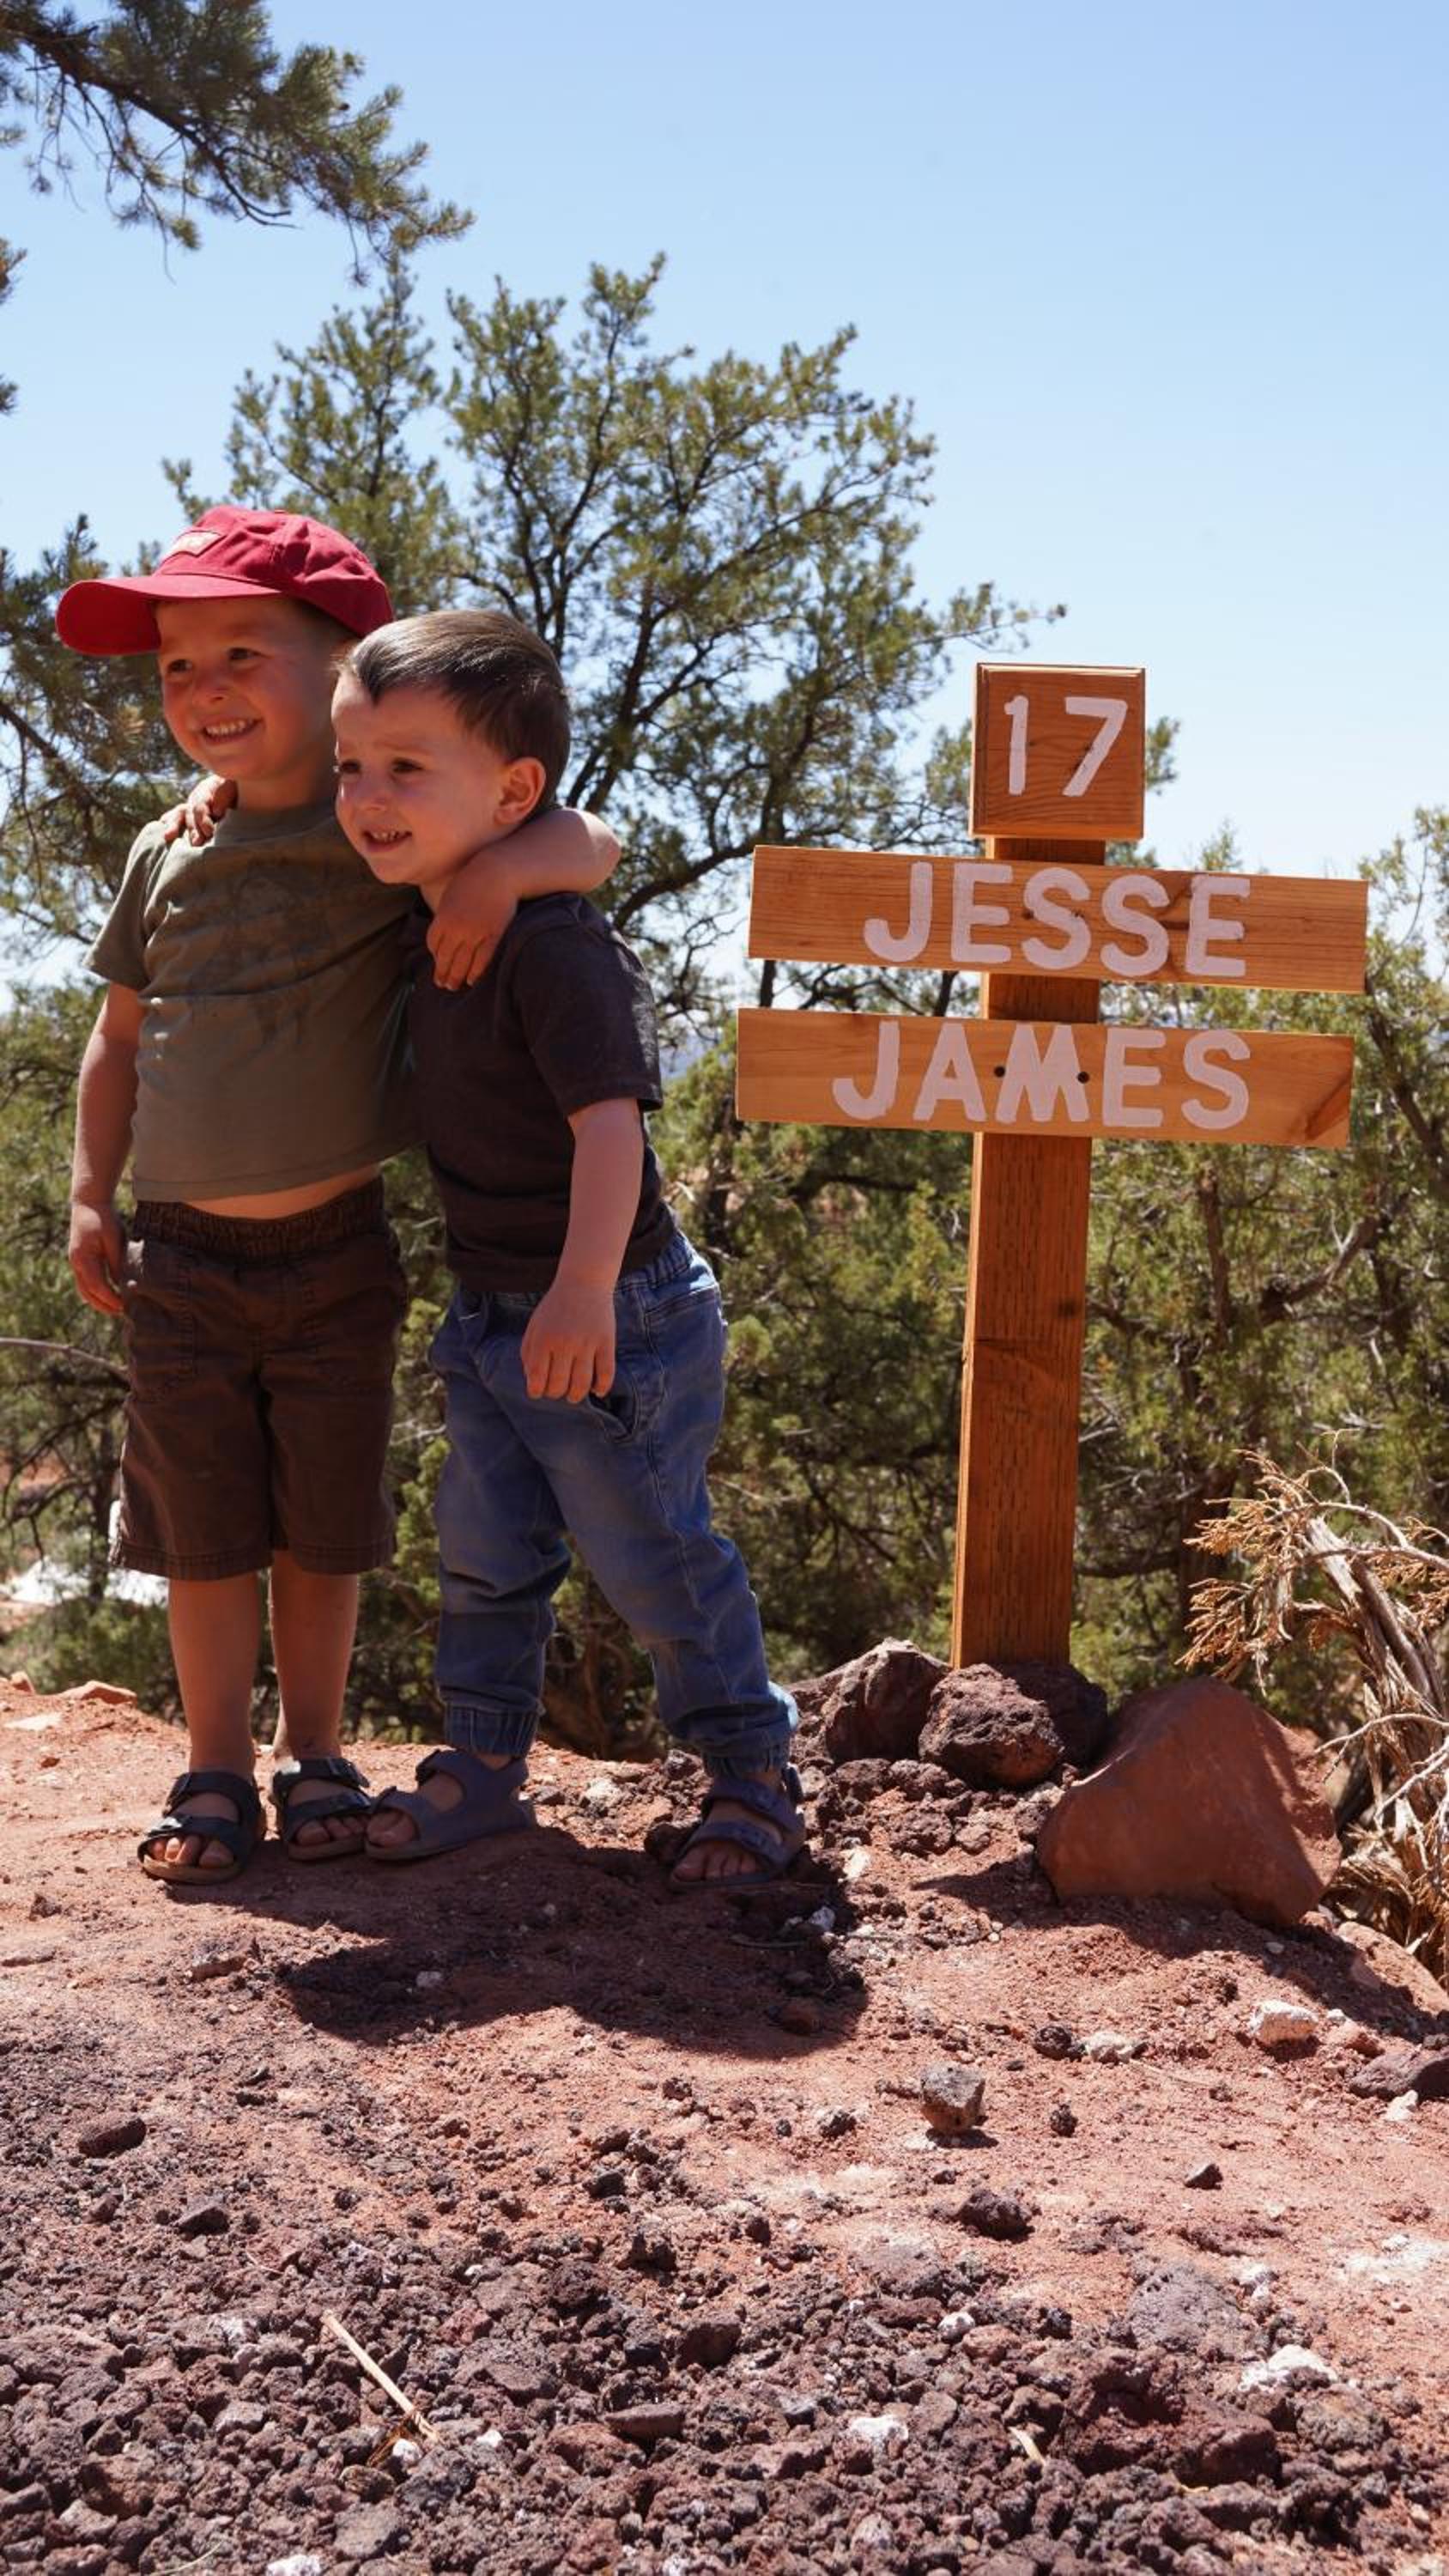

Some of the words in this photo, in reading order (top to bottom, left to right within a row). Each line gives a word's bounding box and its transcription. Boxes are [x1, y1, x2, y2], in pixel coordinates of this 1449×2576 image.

[1004, 696, 1128, 796] 17
[864, 861, 1251, 977] JESSE
[833, 1020, 1251, 1129] JAMES
